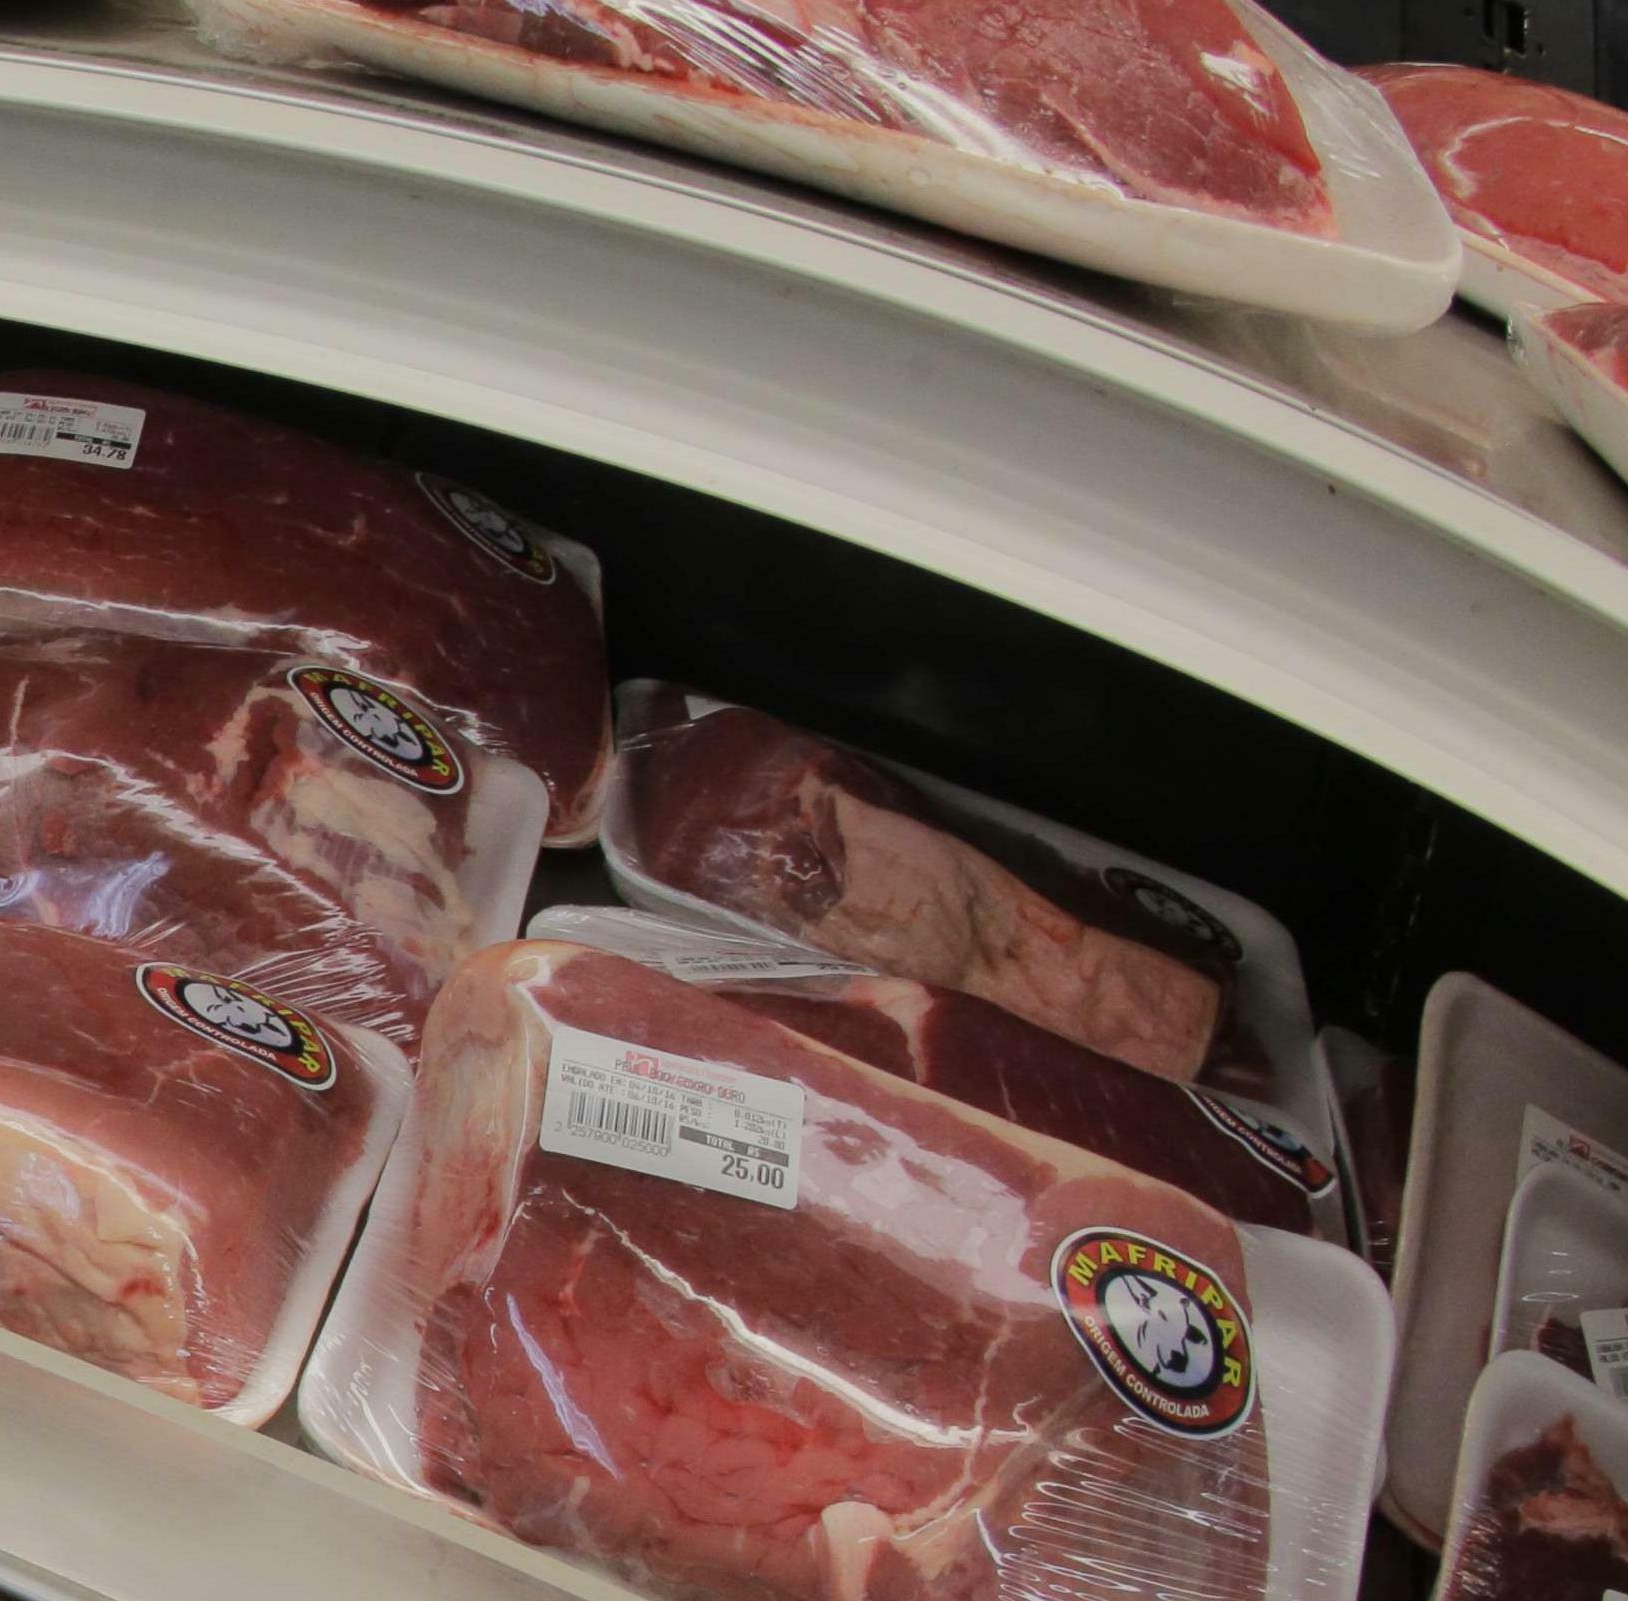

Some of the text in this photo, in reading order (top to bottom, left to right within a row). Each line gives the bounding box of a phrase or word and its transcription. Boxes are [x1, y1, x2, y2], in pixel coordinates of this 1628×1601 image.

[1068, 1242, 1242, 1388] MAFRIPAR
[1083, 1316, 1210, 1418] ORIGEM CONTROLADA
